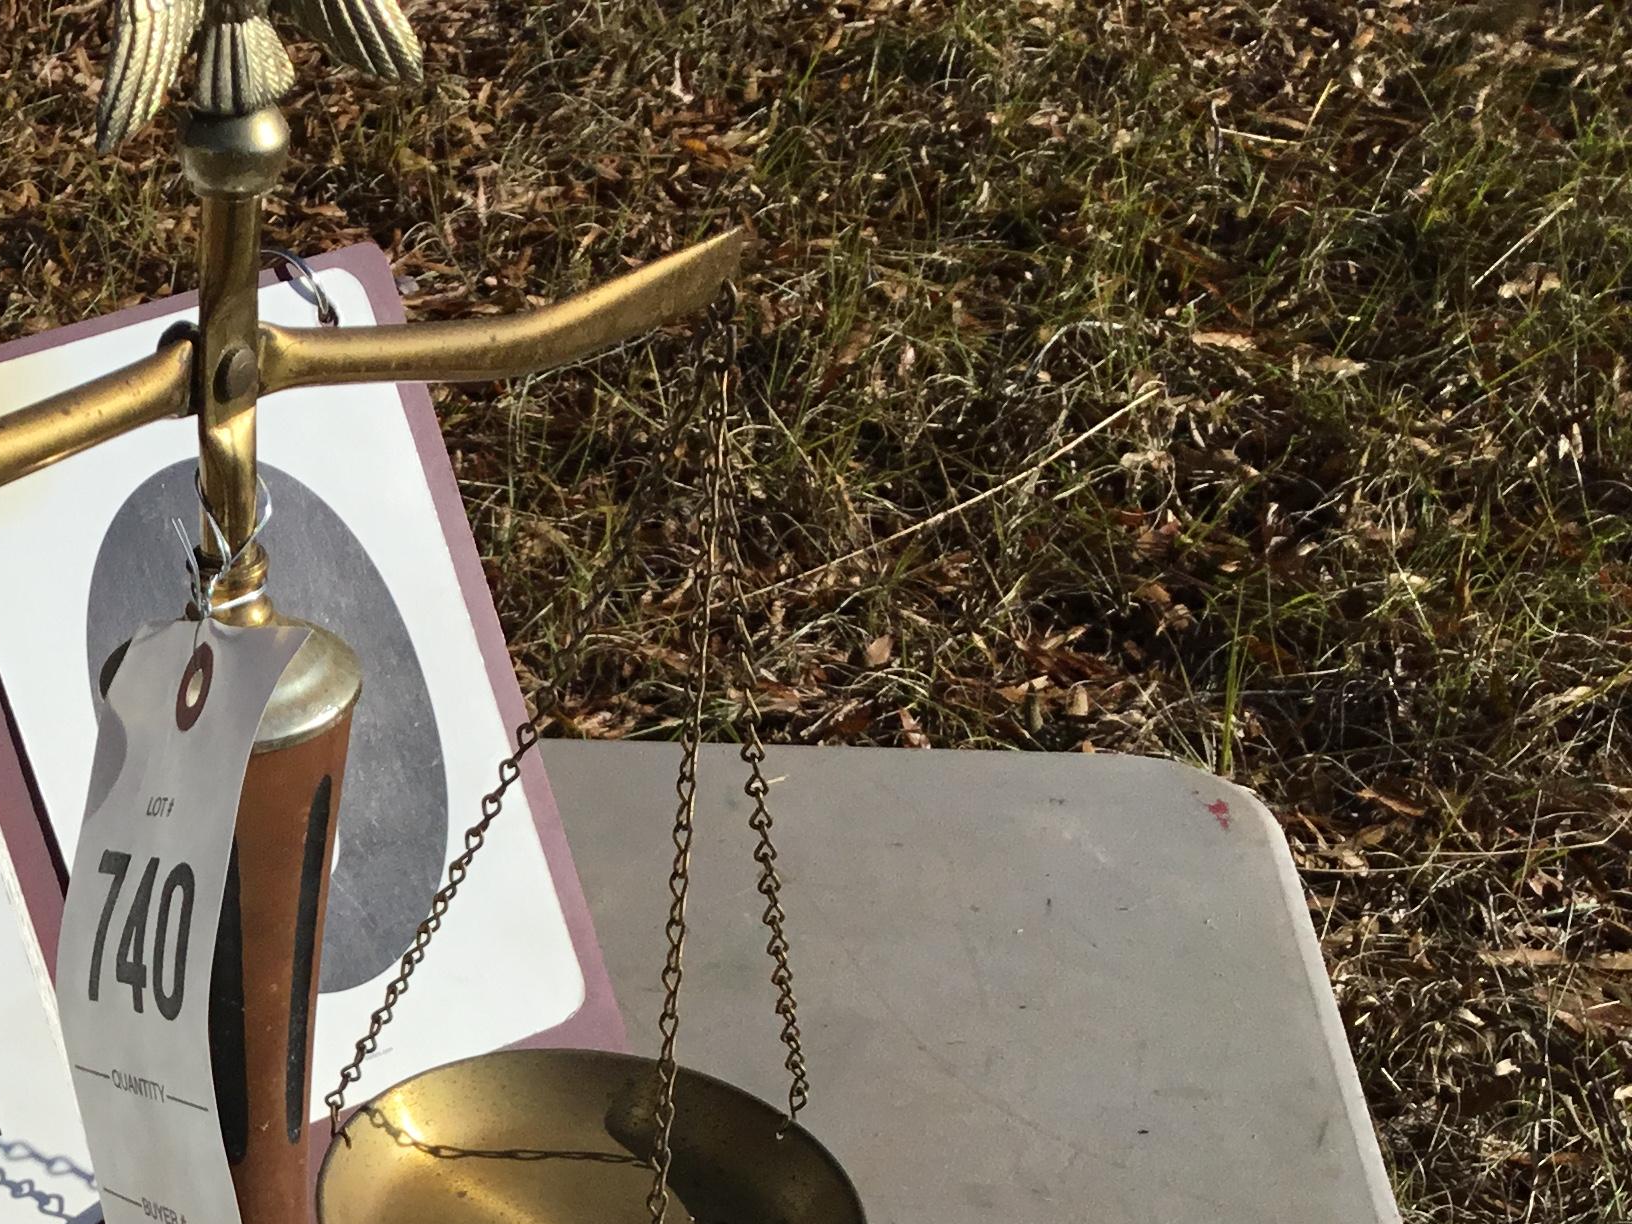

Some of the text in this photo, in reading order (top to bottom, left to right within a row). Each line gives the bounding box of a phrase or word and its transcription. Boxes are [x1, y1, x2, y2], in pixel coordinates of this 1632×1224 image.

[145, 796, 169, 817] LOT
[87, 849, 196, 1022] 740
[111, 1067, 168, 1105] QUANTITY
